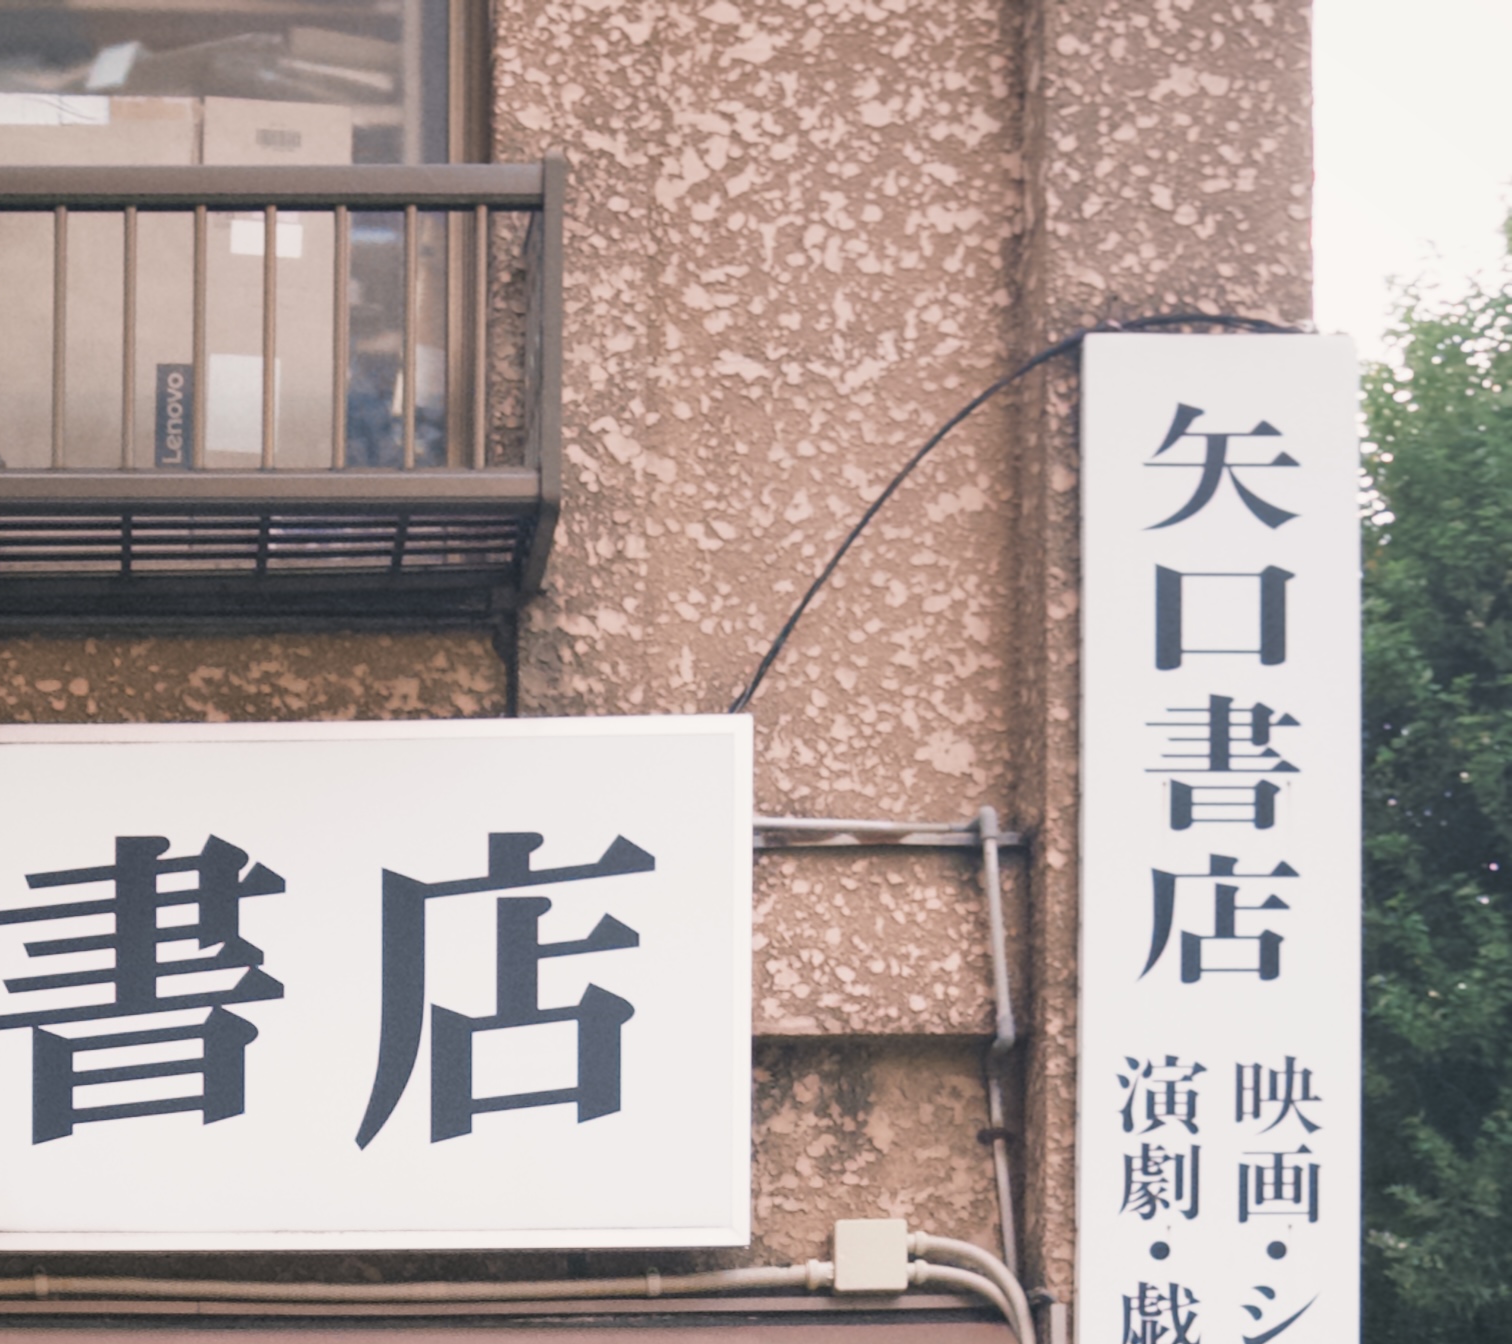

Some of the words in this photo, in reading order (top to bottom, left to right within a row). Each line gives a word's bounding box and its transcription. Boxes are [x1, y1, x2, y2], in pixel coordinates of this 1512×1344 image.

[161, 372, 185, 464] Lenovo
[1137, 402, 1302, 985] 矢口書店
